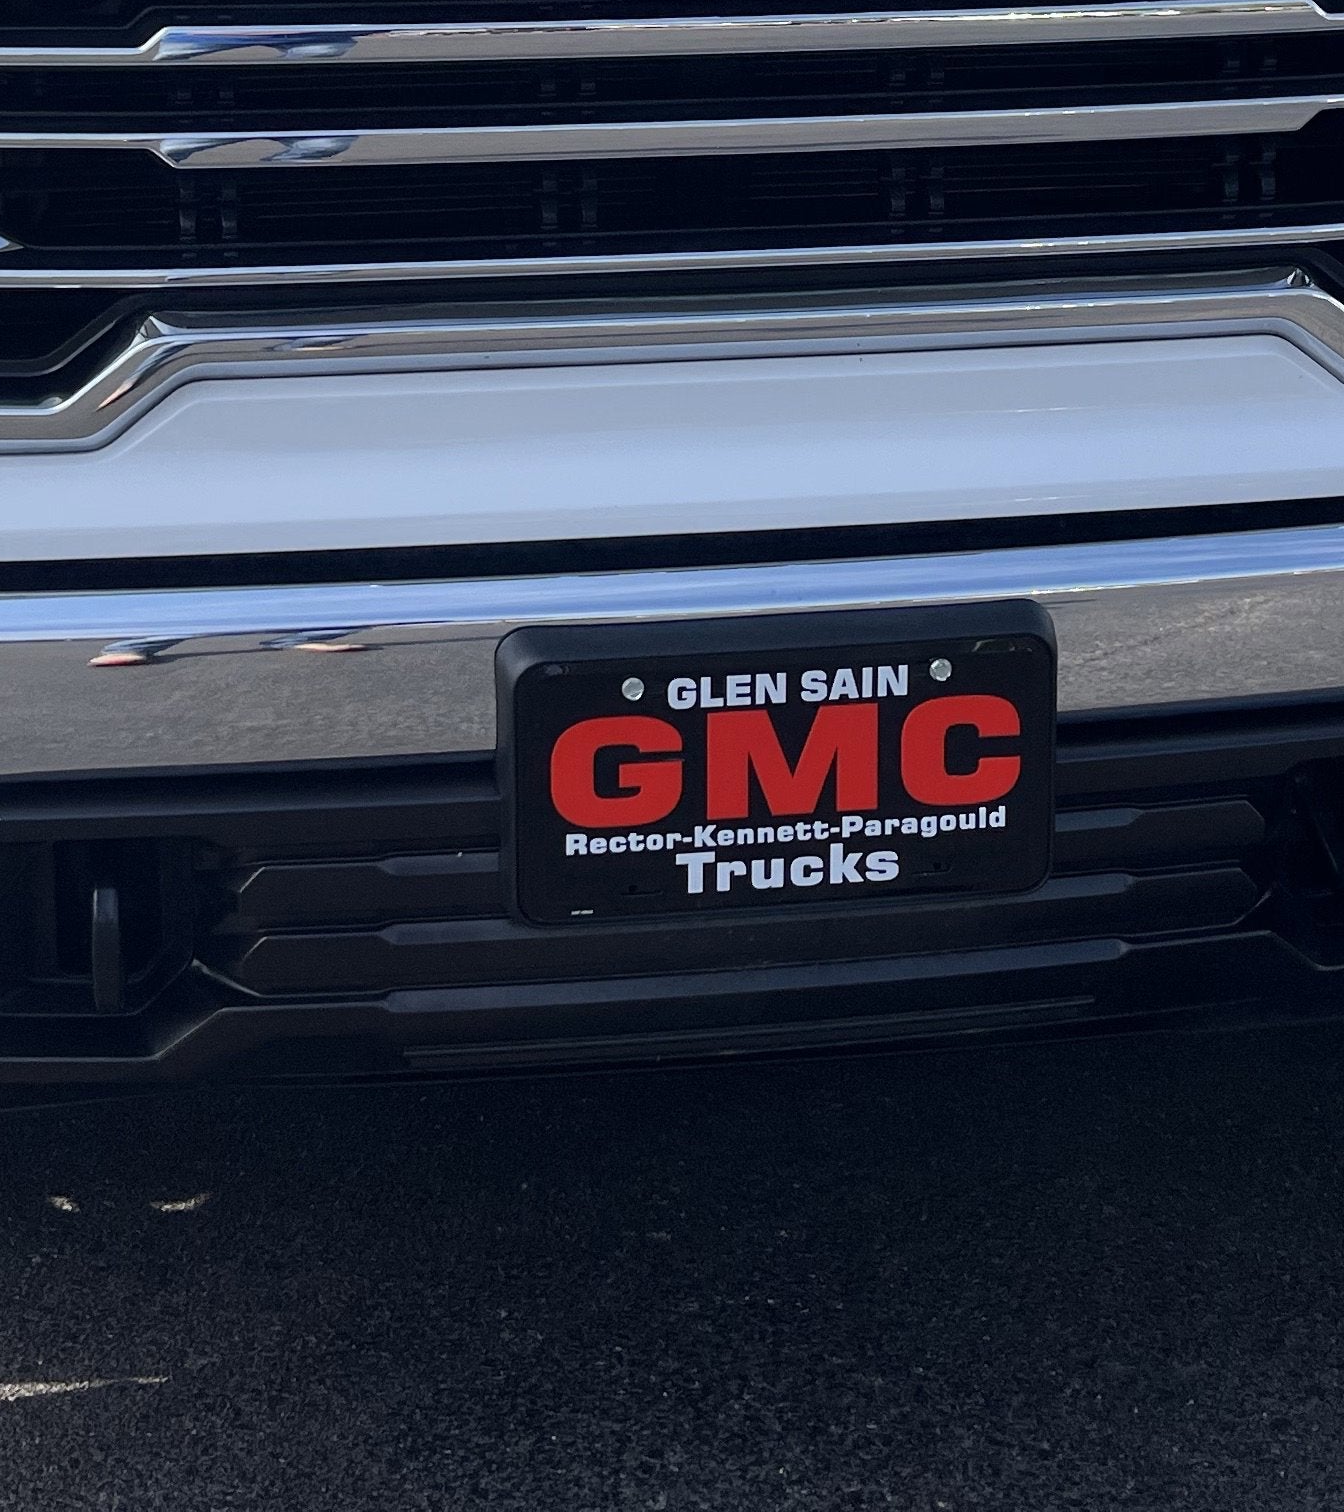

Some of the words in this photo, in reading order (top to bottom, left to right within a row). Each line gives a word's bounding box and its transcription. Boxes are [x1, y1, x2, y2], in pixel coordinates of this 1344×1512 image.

[667, 671, 787, 710] GLEN
[800, 664, 909, 702] SAIN
[550, 694, 1021, 829] GMC
[566, 806, 1007, 856] Rector-Kennett-Paragould
[675, 844, 900, 894] Trucks
